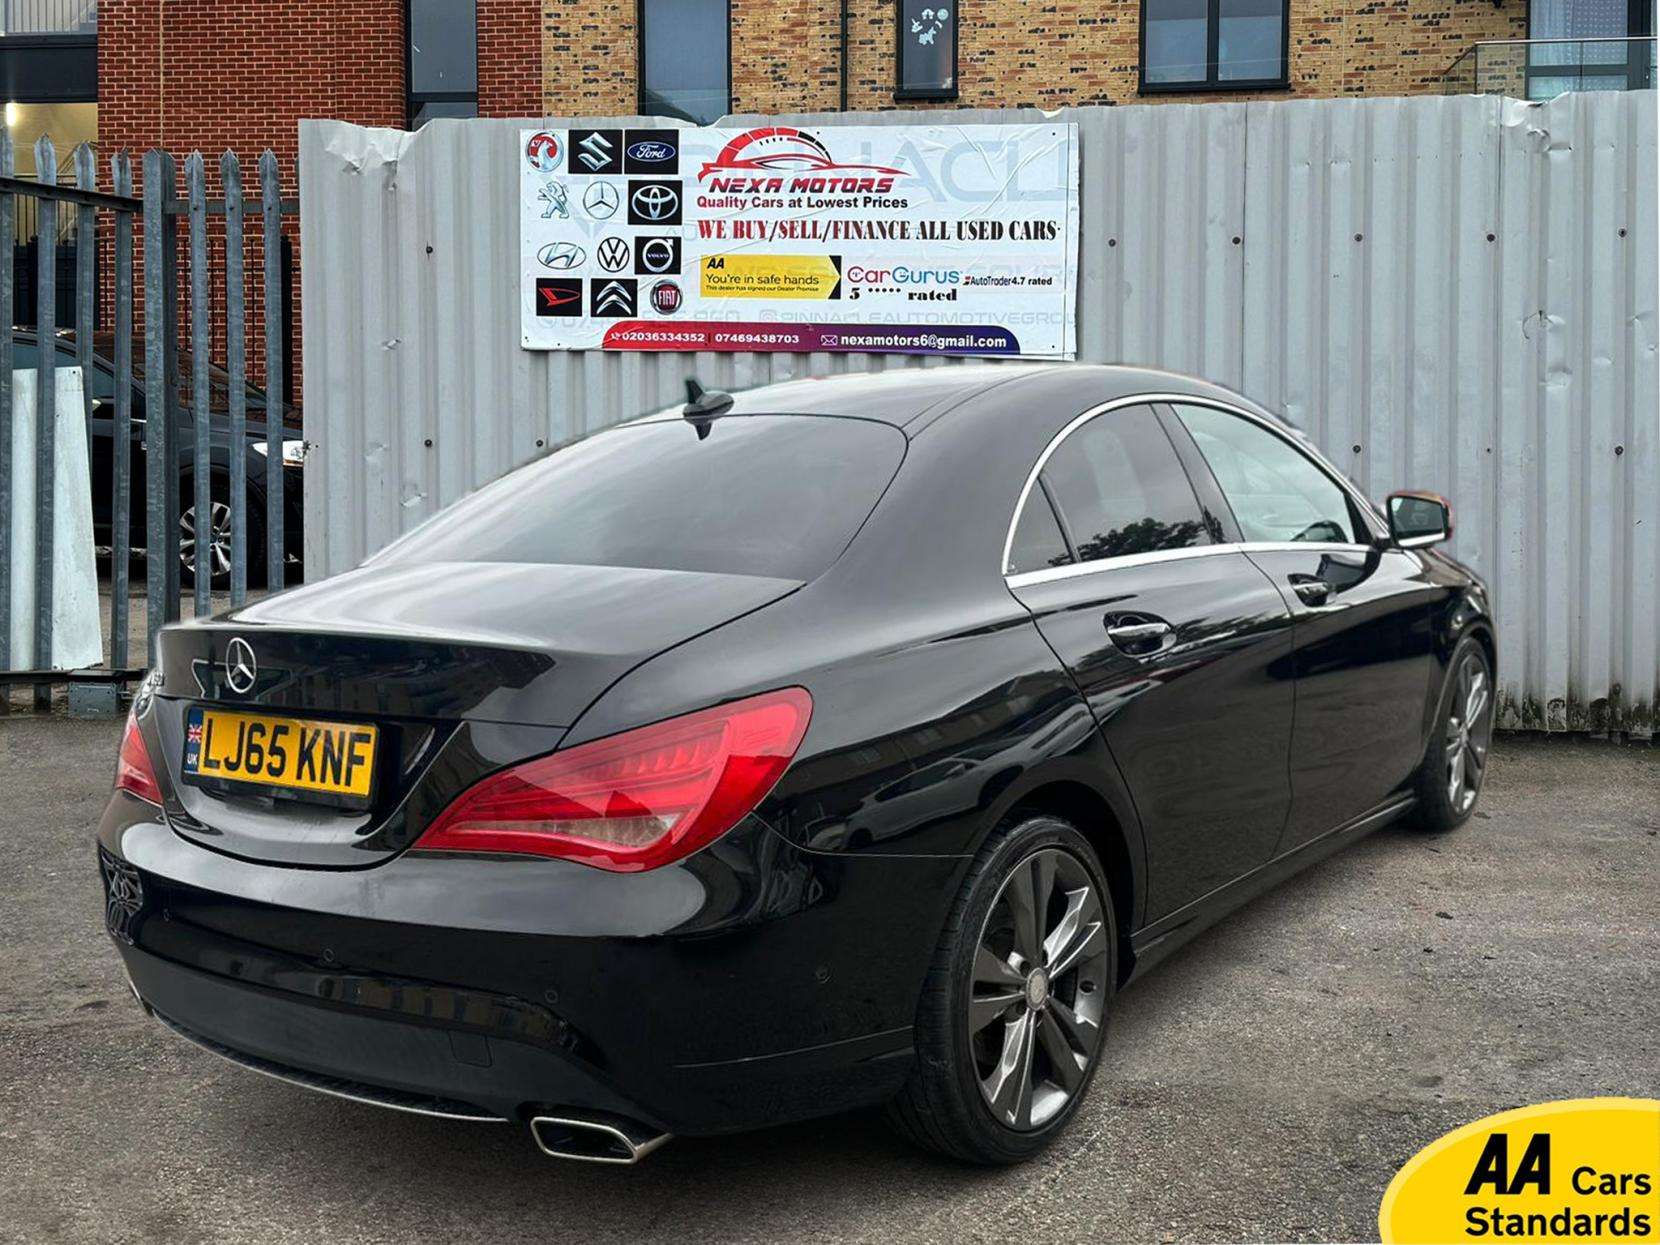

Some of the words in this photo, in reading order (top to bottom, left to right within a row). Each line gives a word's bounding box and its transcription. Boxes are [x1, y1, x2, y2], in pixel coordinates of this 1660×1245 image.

[636, 144, 666, 159] Ford
[709, 177, 784, 194] NEXA
[789, 177, 895, 194] MOTORS
[697, 196, 747, 211] Quality
[751, 196, 784, 209] Cars
[788, 196, 803, 209] at
[807, 196, 859, 209] Lowest
[863, 196, 909, 209] Prices
[697, 220, 727, 240] WE
[732, 219, 911, 243] BUY/SELL/FINANCE
[916, 220, 950, 241] ALL
[956, 220, 1004, 241] USED
[1008, 220, 1057, 241] CARS
[706, 257, 725, 269] AA
[706, 273, 741, 284] You're
[744, 274, 754, 284] in
[757, 274, 781, 285] safe
[783, 274, 820, 285] hands
[847, 265, 960, 285] CarGurus
[1028, 276, 1053, 286] rated
[658, 290, 677, 306] FIAT
[849, 287, 861, 300] 5
[907, 288, 958, 301] rated
[621, 332, 705, 343] 02036334352
[715, 333, 800, 344] 07469438703
[840, 334, 1007, 349] nexamotors6@gmail.com
[186, 752, 199, 765] UK
[203, 717, 290, 778] LJ65
[295, 725, 373, 787] KNF
